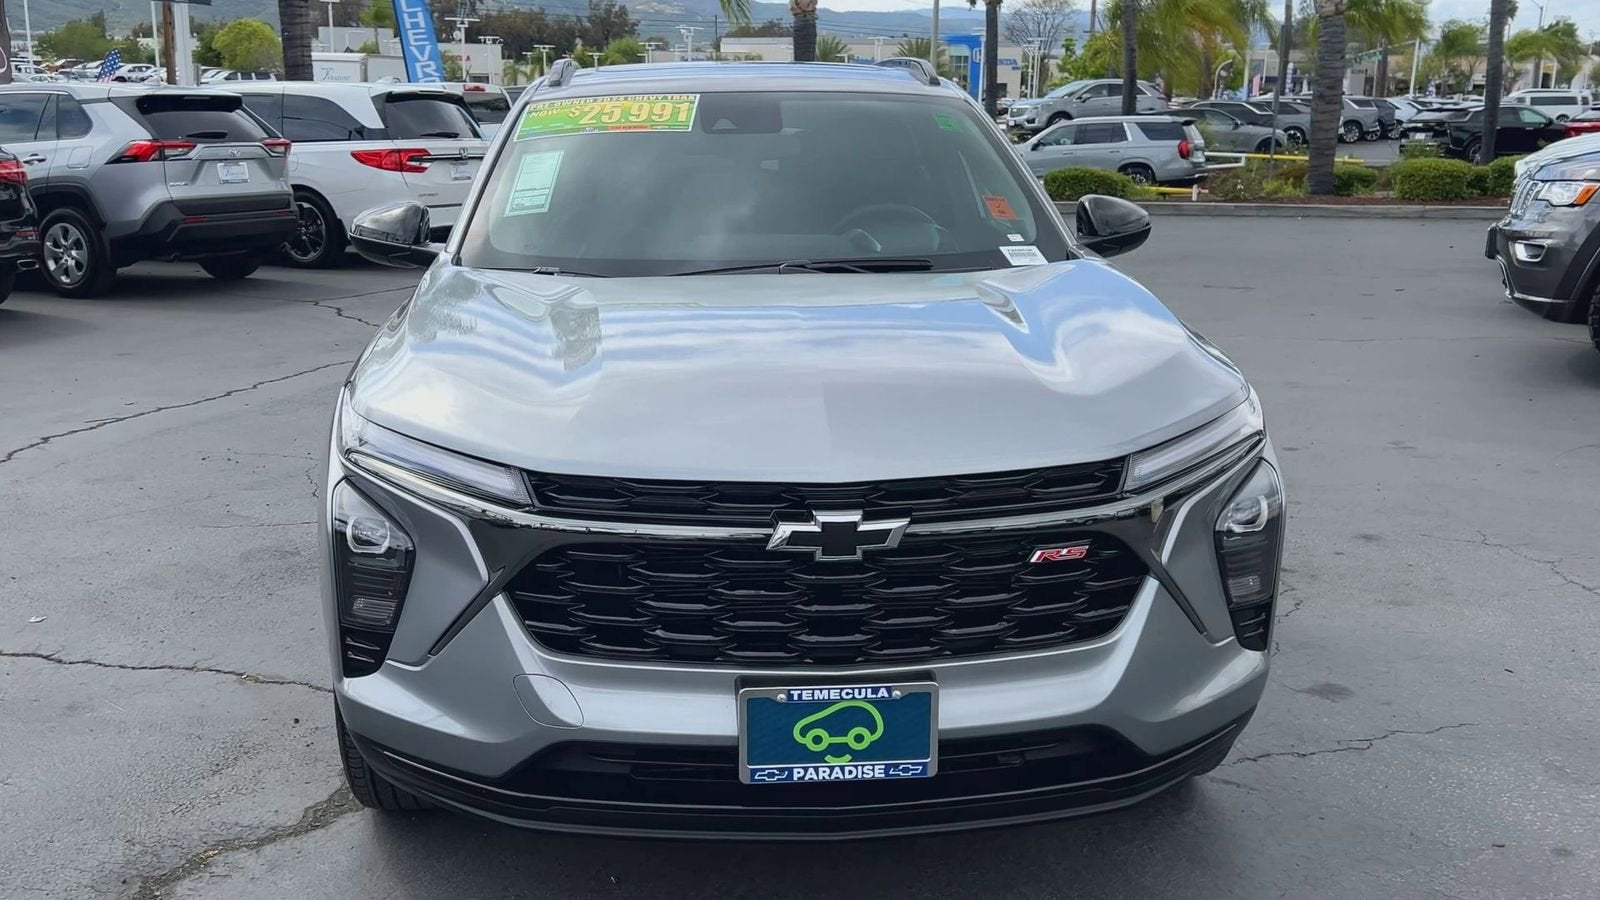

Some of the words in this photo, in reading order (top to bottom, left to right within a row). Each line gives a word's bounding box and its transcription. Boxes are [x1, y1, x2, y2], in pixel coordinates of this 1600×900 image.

[528, 108, 562, 118] NOW
[1030, 545, 1089, 563] RS
[790, 687, 889, 701] TEMECULA
[792, 765, 886, 781] PARADISE
